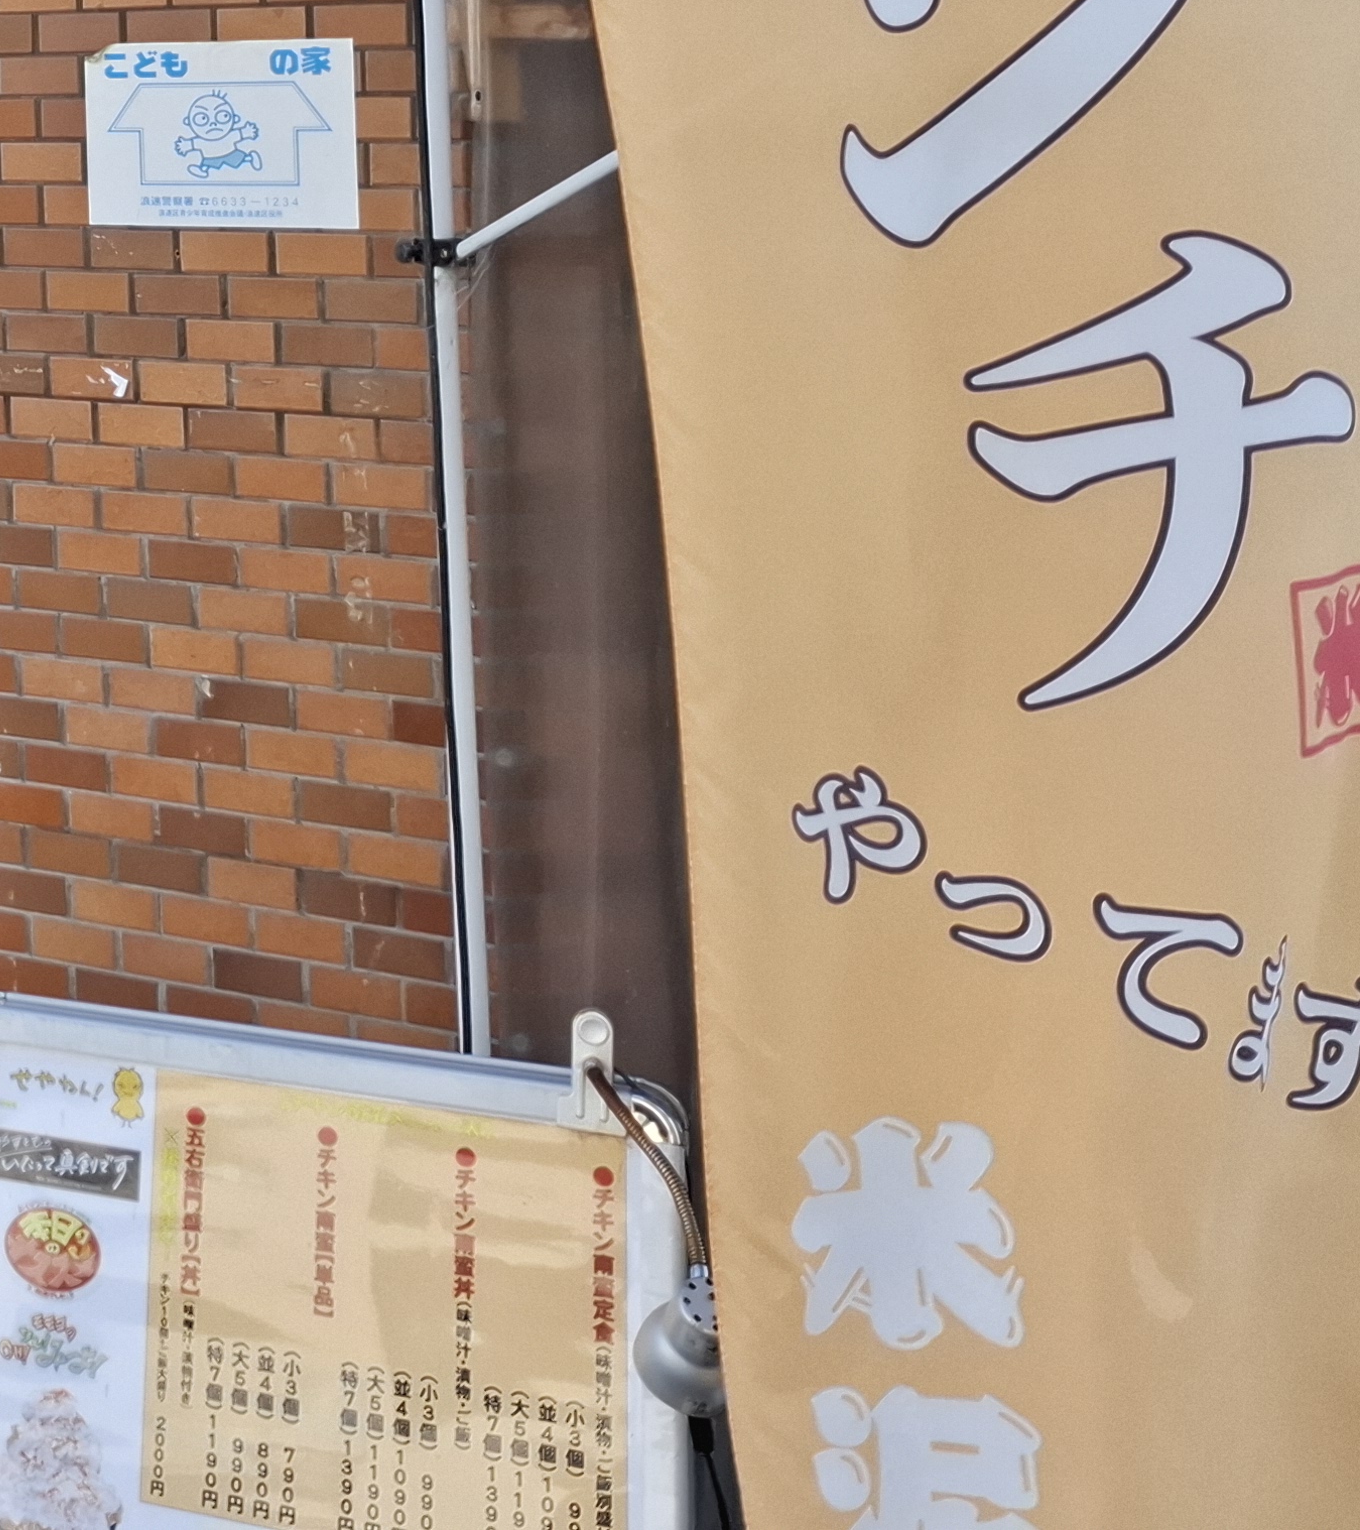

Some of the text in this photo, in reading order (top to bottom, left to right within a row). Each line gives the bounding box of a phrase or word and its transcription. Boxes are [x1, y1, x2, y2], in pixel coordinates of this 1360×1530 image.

[103, 46, 332, 80] こども の家
[149, 1416, 167, 1498] 2000円
[201, 1414, 219, 1509] 1190円
[227, 1438, 244, 1515] 990円
[252, 1442, 270, 1520] 890円
[278, 1447, 296, 1525] 790円
